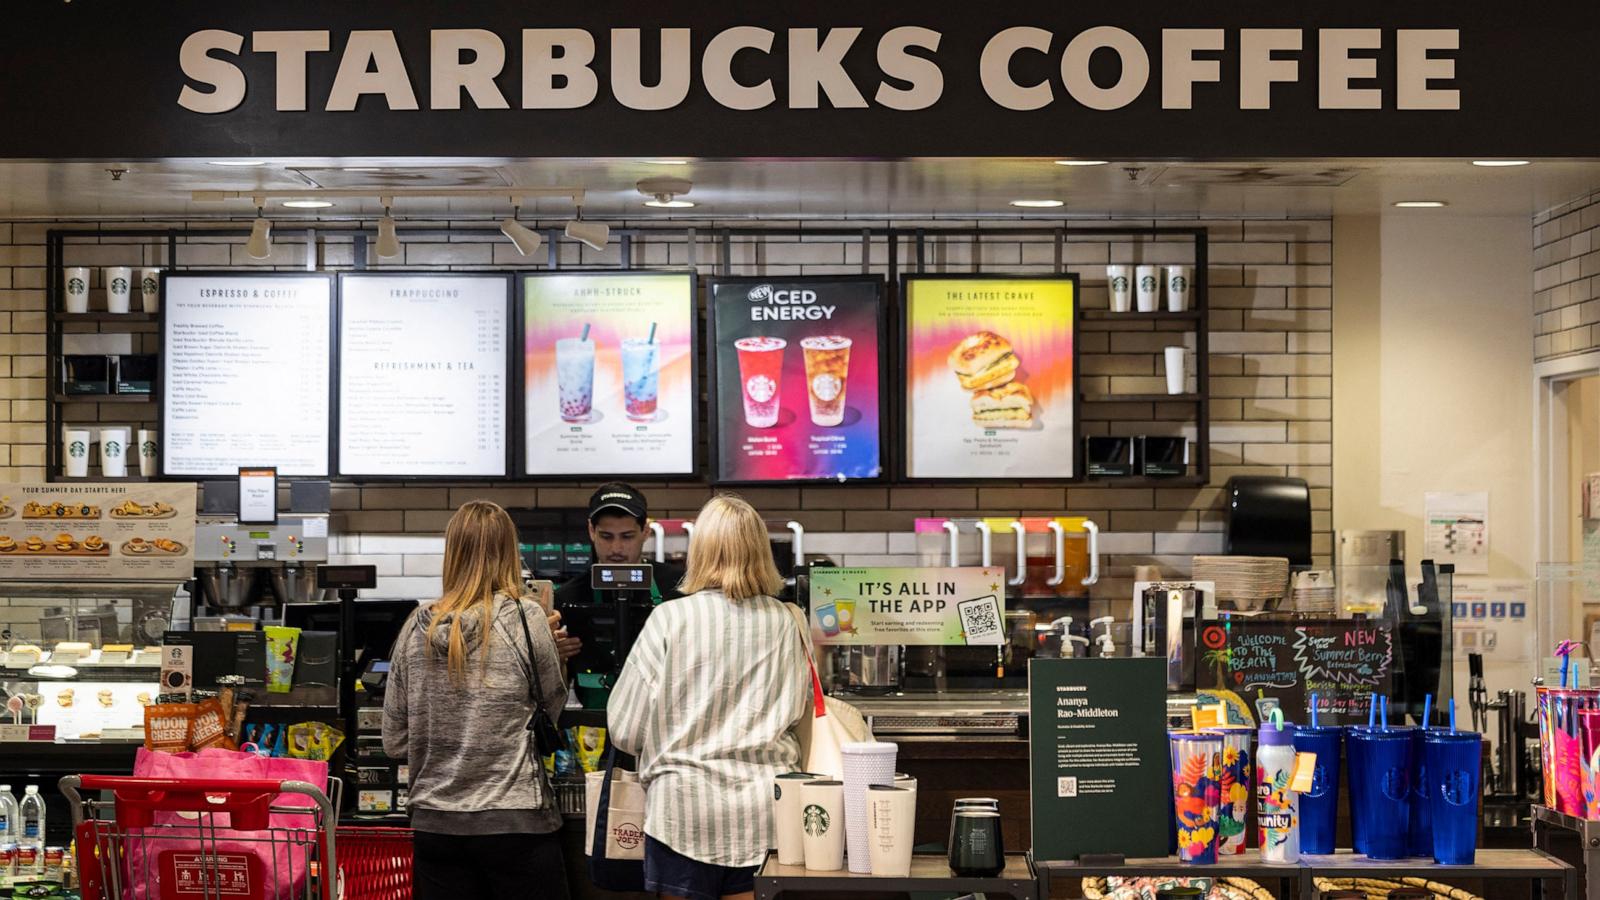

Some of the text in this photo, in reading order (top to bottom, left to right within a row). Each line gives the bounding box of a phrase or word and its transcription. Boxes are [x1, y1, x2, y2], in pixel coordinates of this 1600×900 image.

[177, 26, 1460, 114] STARBUCKS COFFEE
[200, 288, 248, 298] ESPRESSO
[254, 288, 259, 298] &
[390, 289, 459, 298] FRAPPUCCINO
[768, 290, 817, 304] ICED
[948, 292, 1035, 300] THE LATEST CRAVE
[751, 306, 836, 321] ENERGY
[446, 362, 452, 370] &
[458, 362, 474, 370] TEA
[859, 582, 956, 596] IT'S ALL IN
[868, 600, 946, 612] THE APP
[1344, 631, 1376, 646] NEW
[1235, 647, 1248, 656] TO
[1313, 648, 1387, 664] Summer Berry
[1057, 697, 1088, 707] Ananya
[1057, 708, 1118, 718] Rao-Middleton
[151, 717, 188, 729] MOON
[193, 710, 220, 732] OON
[151, 729, 188, 740] CHEESE
[613, 828, 644, 838] TRADER
